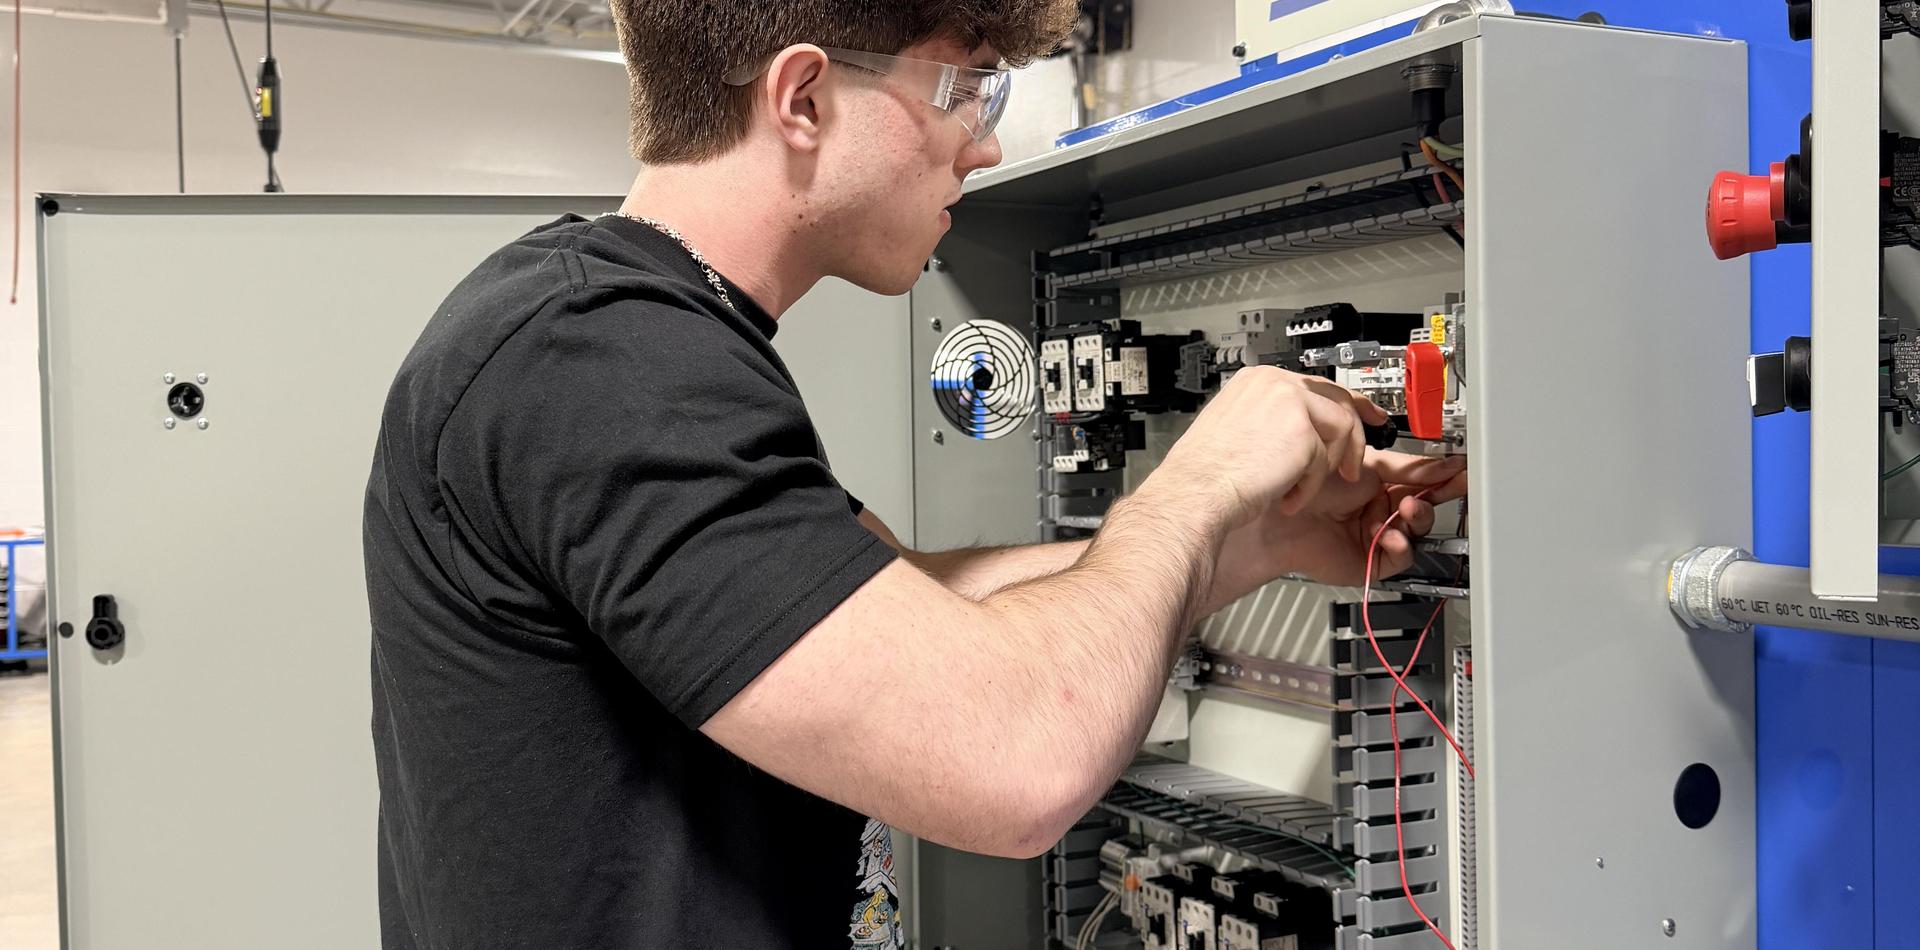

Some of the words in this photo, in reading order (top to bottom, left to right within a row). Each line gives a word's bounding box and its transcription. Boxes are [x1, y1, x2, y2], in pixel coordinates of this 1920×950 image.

[1751, 600, 1770, 614] WET
[1776, 603, 1804, 617] 60°C
[1809, 606, 1860, 623] OIL-RES
[1865, 612, 1920, 630] SUN-RES
